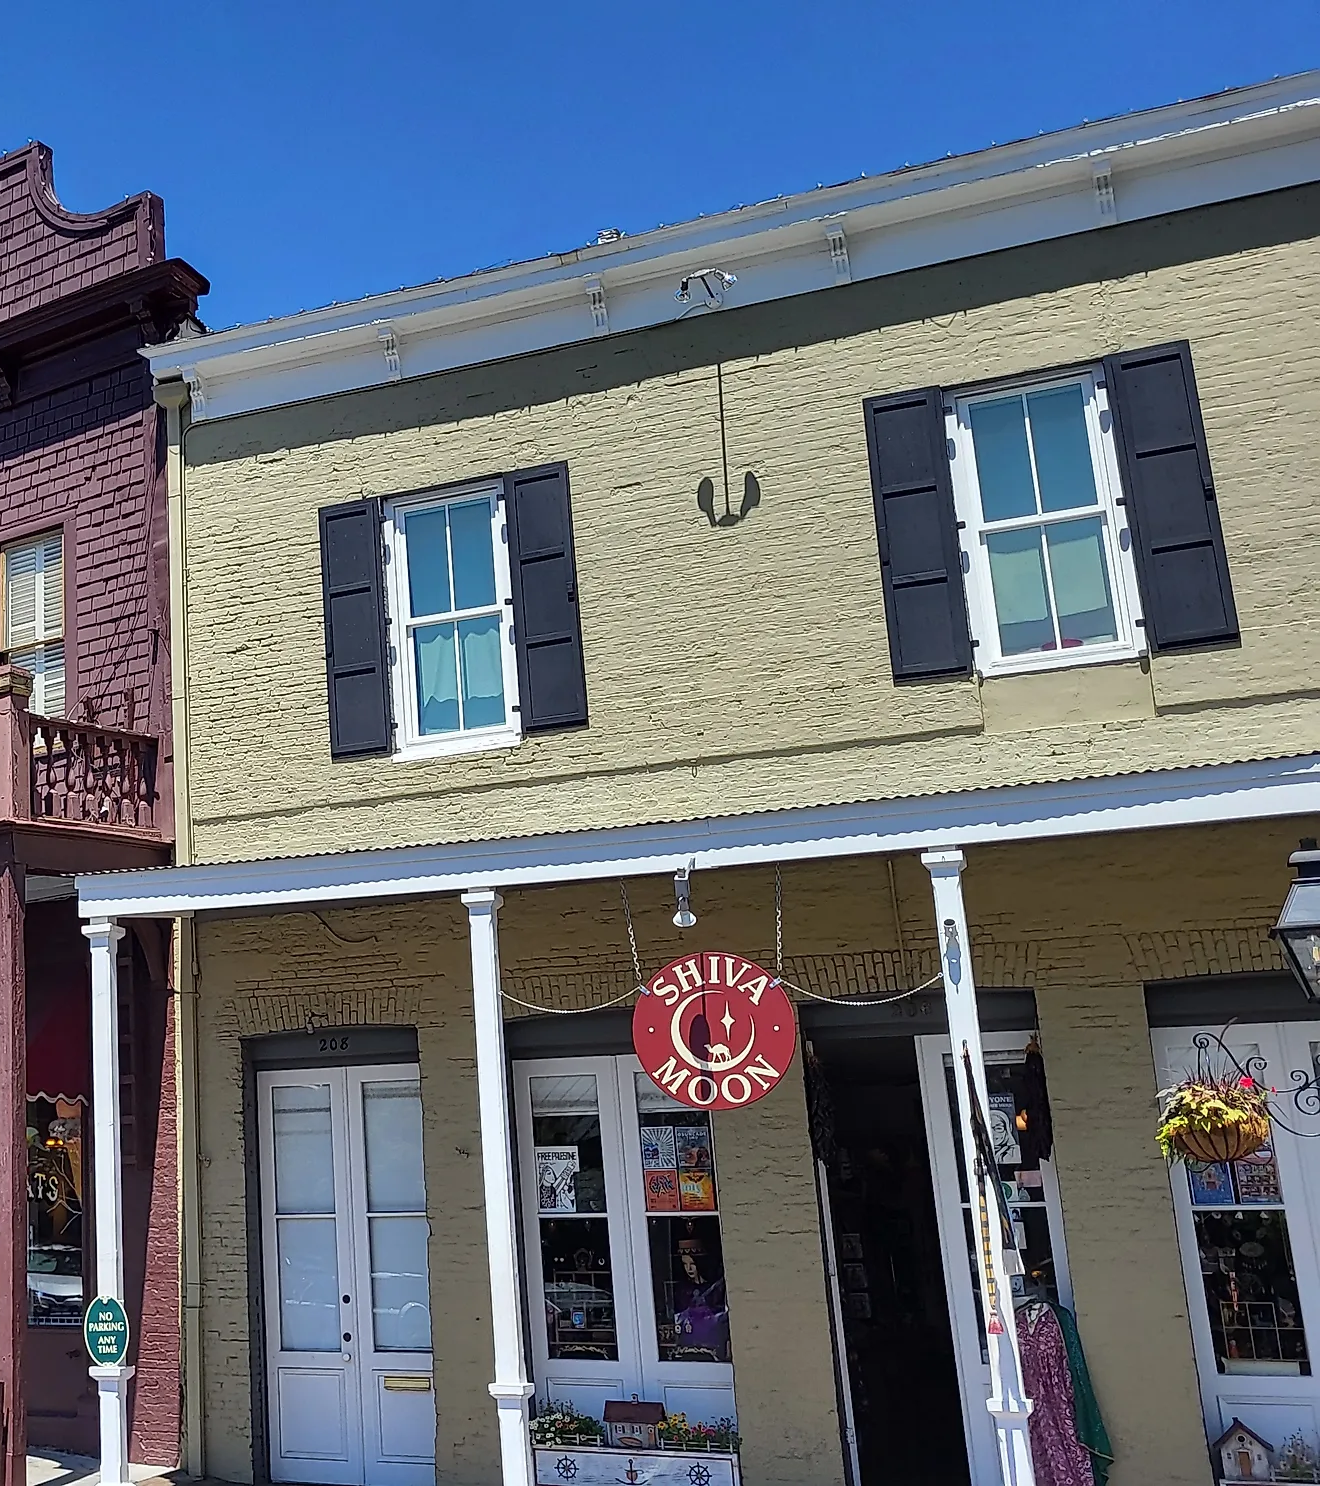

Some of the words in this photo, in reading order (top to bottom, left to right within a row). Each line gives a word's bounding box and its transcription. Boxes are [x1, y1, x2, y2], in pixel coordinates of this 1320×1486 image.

[652, 956, 769, 1006] SHIVA
[319, 1036, 349, 1051] 208
[652, 1054, 781, 1106] MOON
[537, 1151, 551, 1161] FREE
[552, 1151, 576, 1161] PALESTINE
[98, 1311, 114, 1322] NO
[88, 1321, 125, 1332] PARKING
[97, 1335, 117, 1345] ANY
[97, 1344, 118, 1354] TIME
